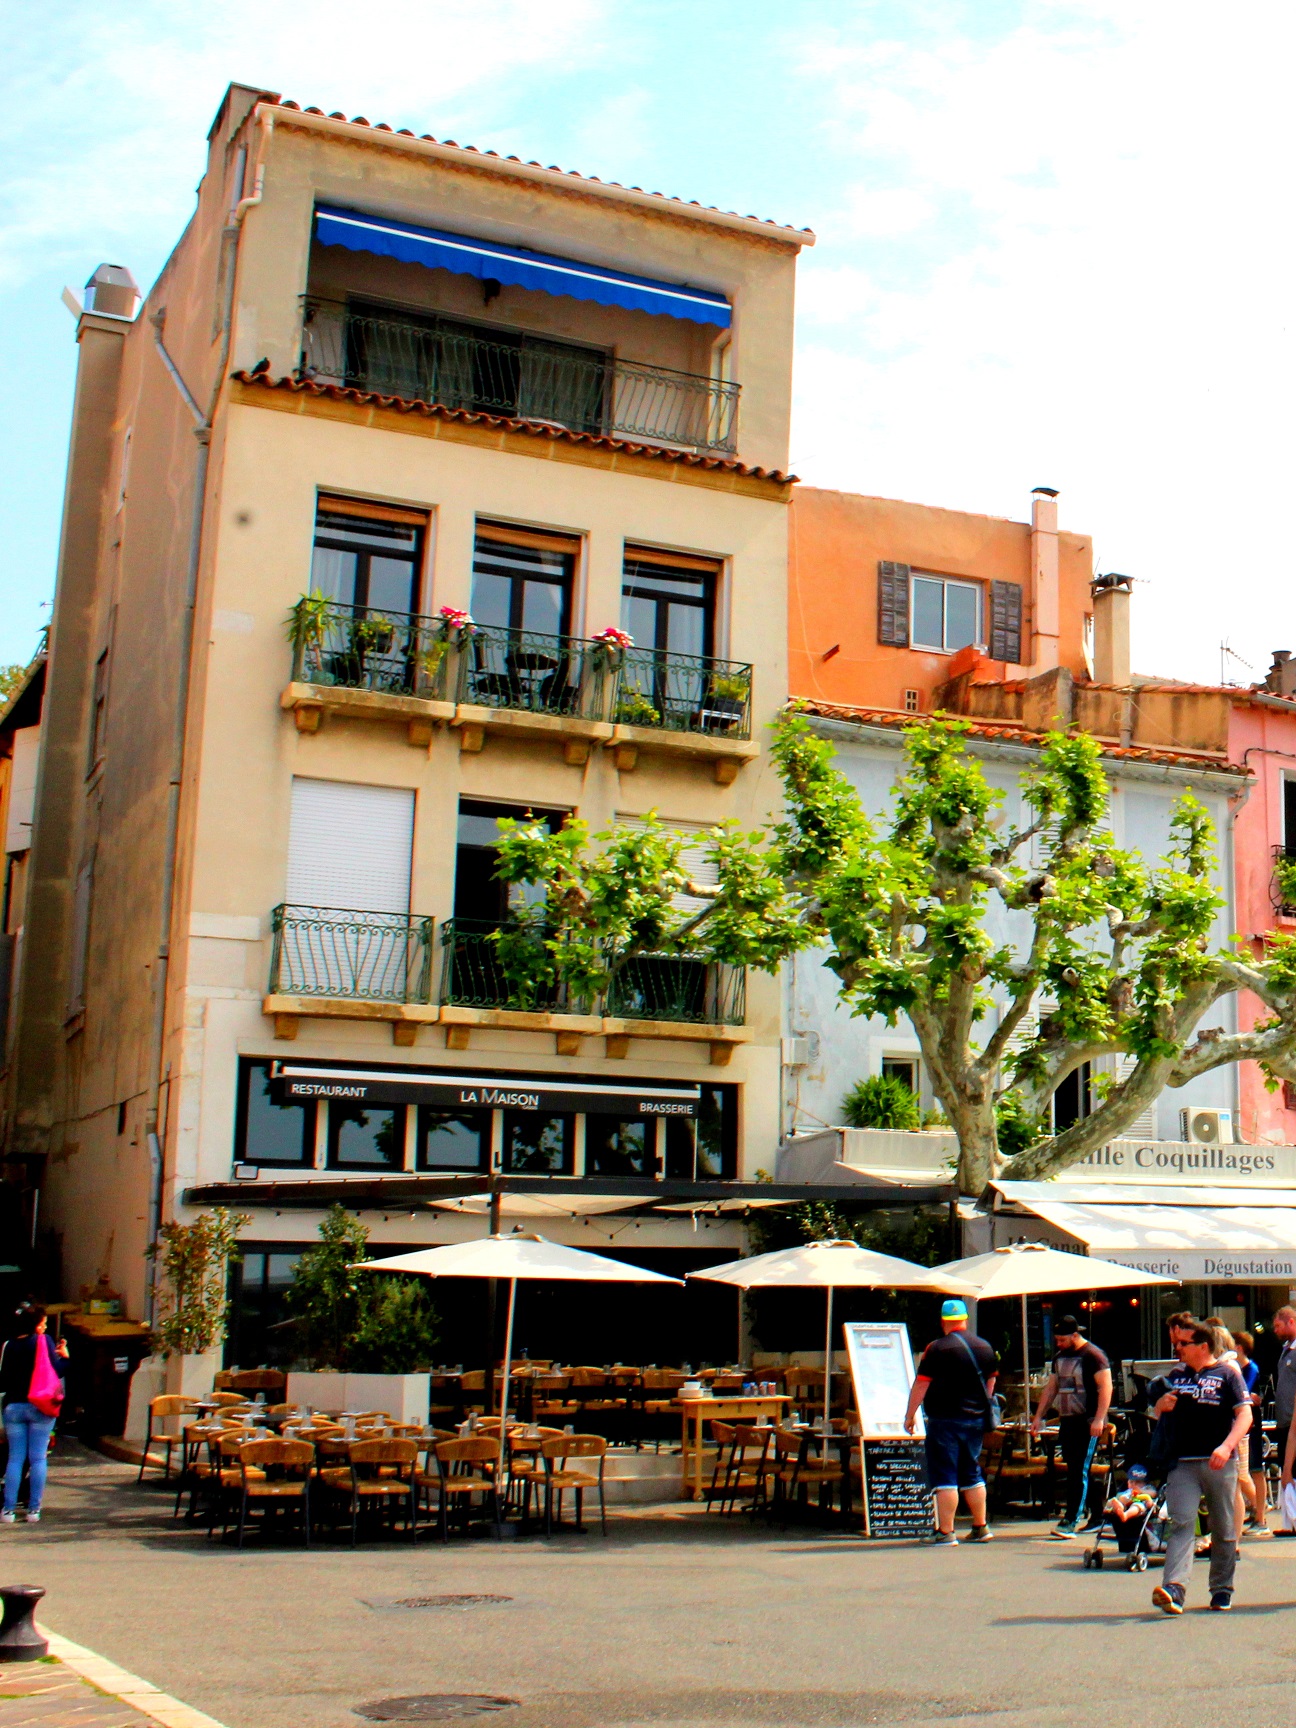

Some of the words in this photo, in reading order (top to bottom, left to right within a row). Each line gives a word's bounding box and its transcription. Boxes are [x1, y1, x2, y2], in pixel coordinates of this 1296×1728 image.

[291, 1083, 367, 1098] RESTAURANT
[460, 1090, 478, 1103] LA
[481, 1088, 539, 1106] MAISON
[639, 1102, 694, 1115] BRASSERIE
[1135, 1147, 1275, 1174] Coquillages
[1203, 1257, 1293, 1278] Dégustation
